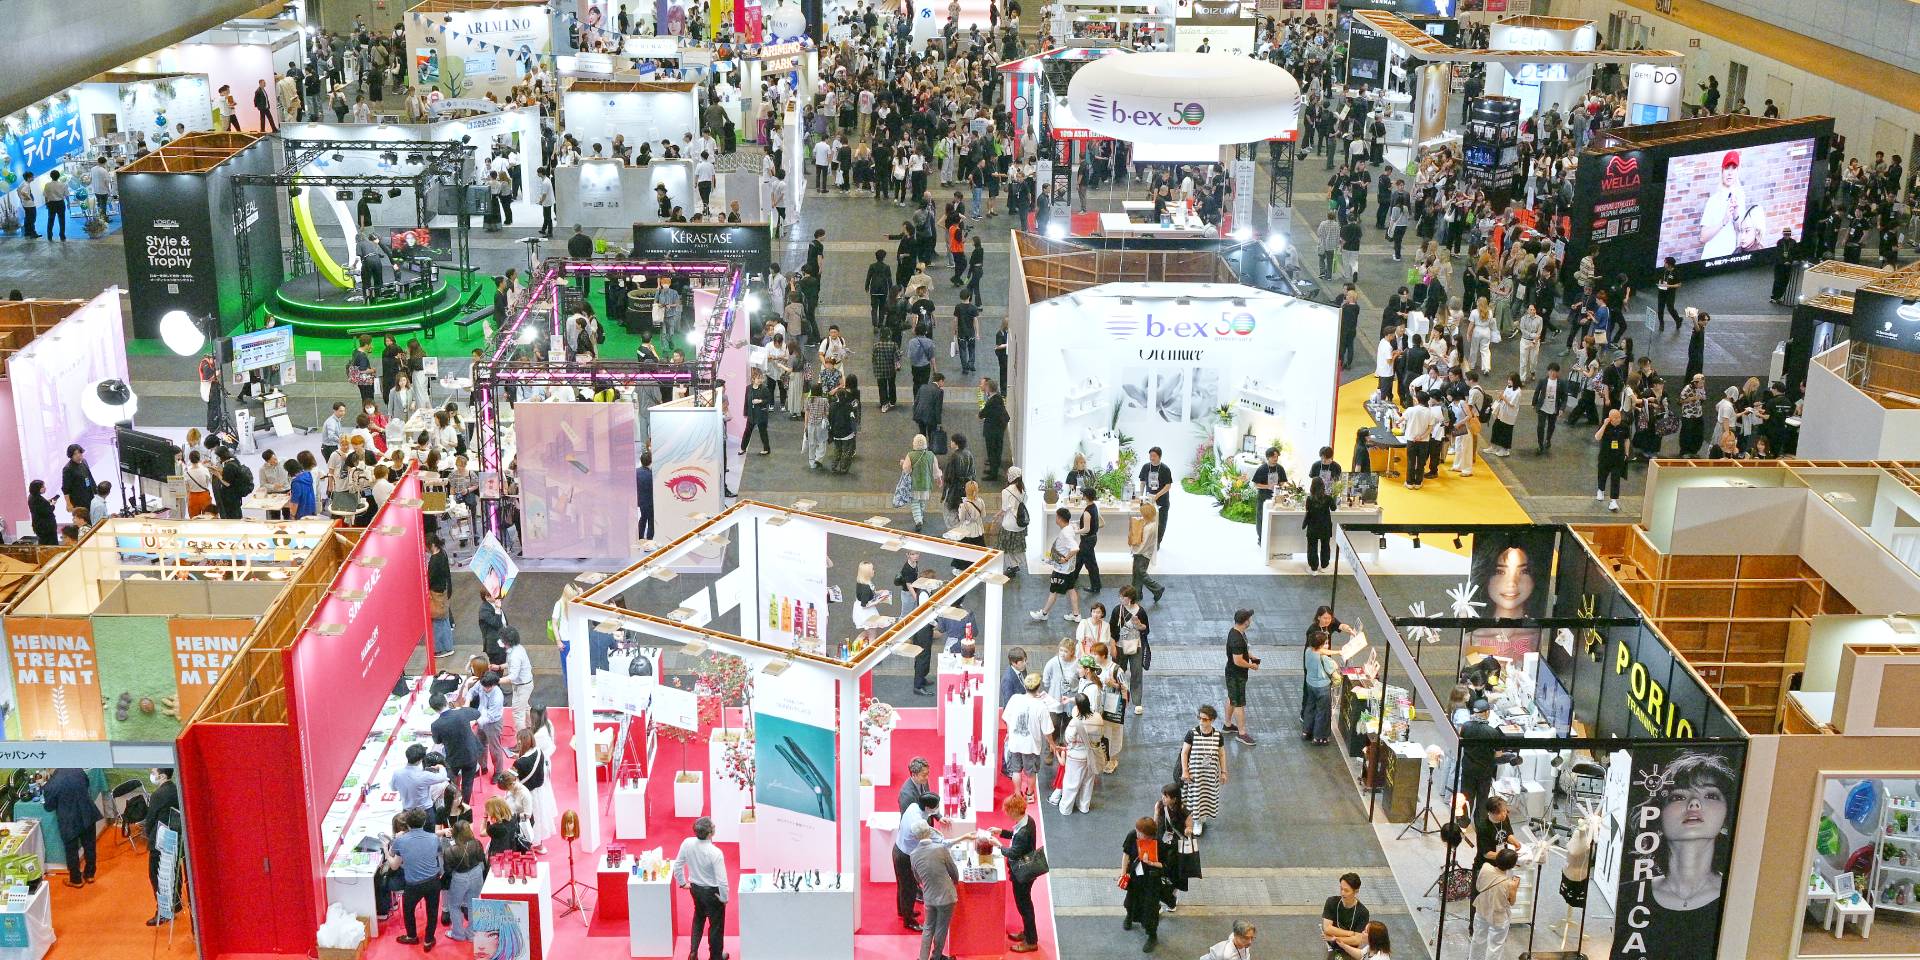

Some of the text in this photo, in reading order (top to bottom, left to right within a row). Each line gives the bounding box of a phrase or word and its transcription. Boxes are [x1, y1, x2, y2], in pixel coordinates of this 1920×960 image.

[1195, 7, 1236, 15] KOIZUMI
[466, 18, 531, 35] ARIMINO
[761, 42, 800, 57] ARIMINO
[769, 57, 792, 71] PARK
[1520, 64, 1568, 79] DEMI
[1654, 71, 1677, 85] DO
[1168, 103, 1205, 126] 50
[1602, 174, 1641, 191] WELLA
[146, 235, 191, 248] Style &
[671, 230, 732, 244] KÉRASTASE
[147, 245, 192, 256] Colour
[148, 256, 192, 268] Trophy
[1215, 311, 1256, 336] 50
[12, 635, 90, 651] HENNA
[14, 652, 93, 668] TREAT-
[18, 670, 93, 685] MENT
[181, 671, 219, 685] ME
[1621, 806, 1661, 953] PORICA
